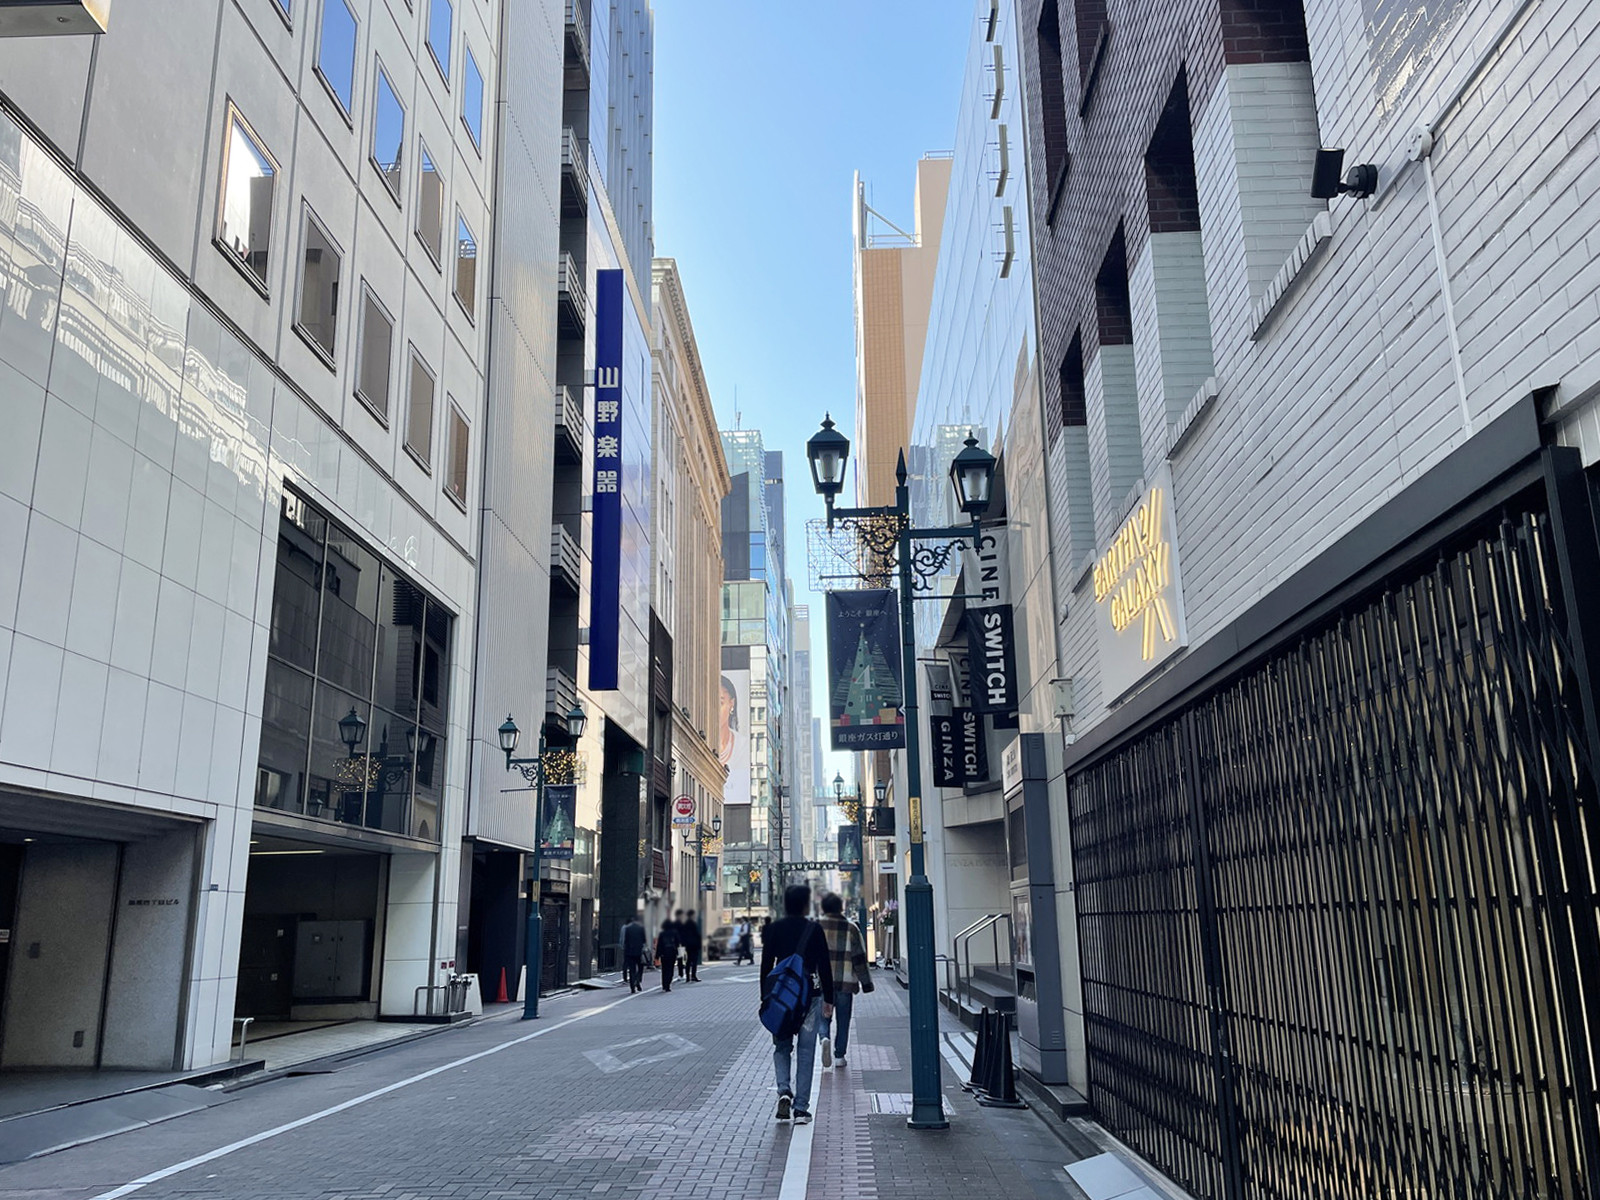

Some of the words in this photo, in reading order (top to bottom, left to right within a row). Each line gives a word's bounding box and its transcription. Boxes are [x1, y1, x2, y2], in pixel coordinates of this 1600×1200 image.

[597, 366, 618, 493] 山野楽器
[980, 535, 1000, 601] CINE
[1094, 520, 1136, 602] EARTH
[1111, 542, 1164, 632] GALAXY
[983, 613, 1007, 705] SWITCH
[838, 731, 898, 743] 銀座ガス灯通り
[941, 720, 954, 781] GINZA
[963, 711, 978, 776] SWITCH
